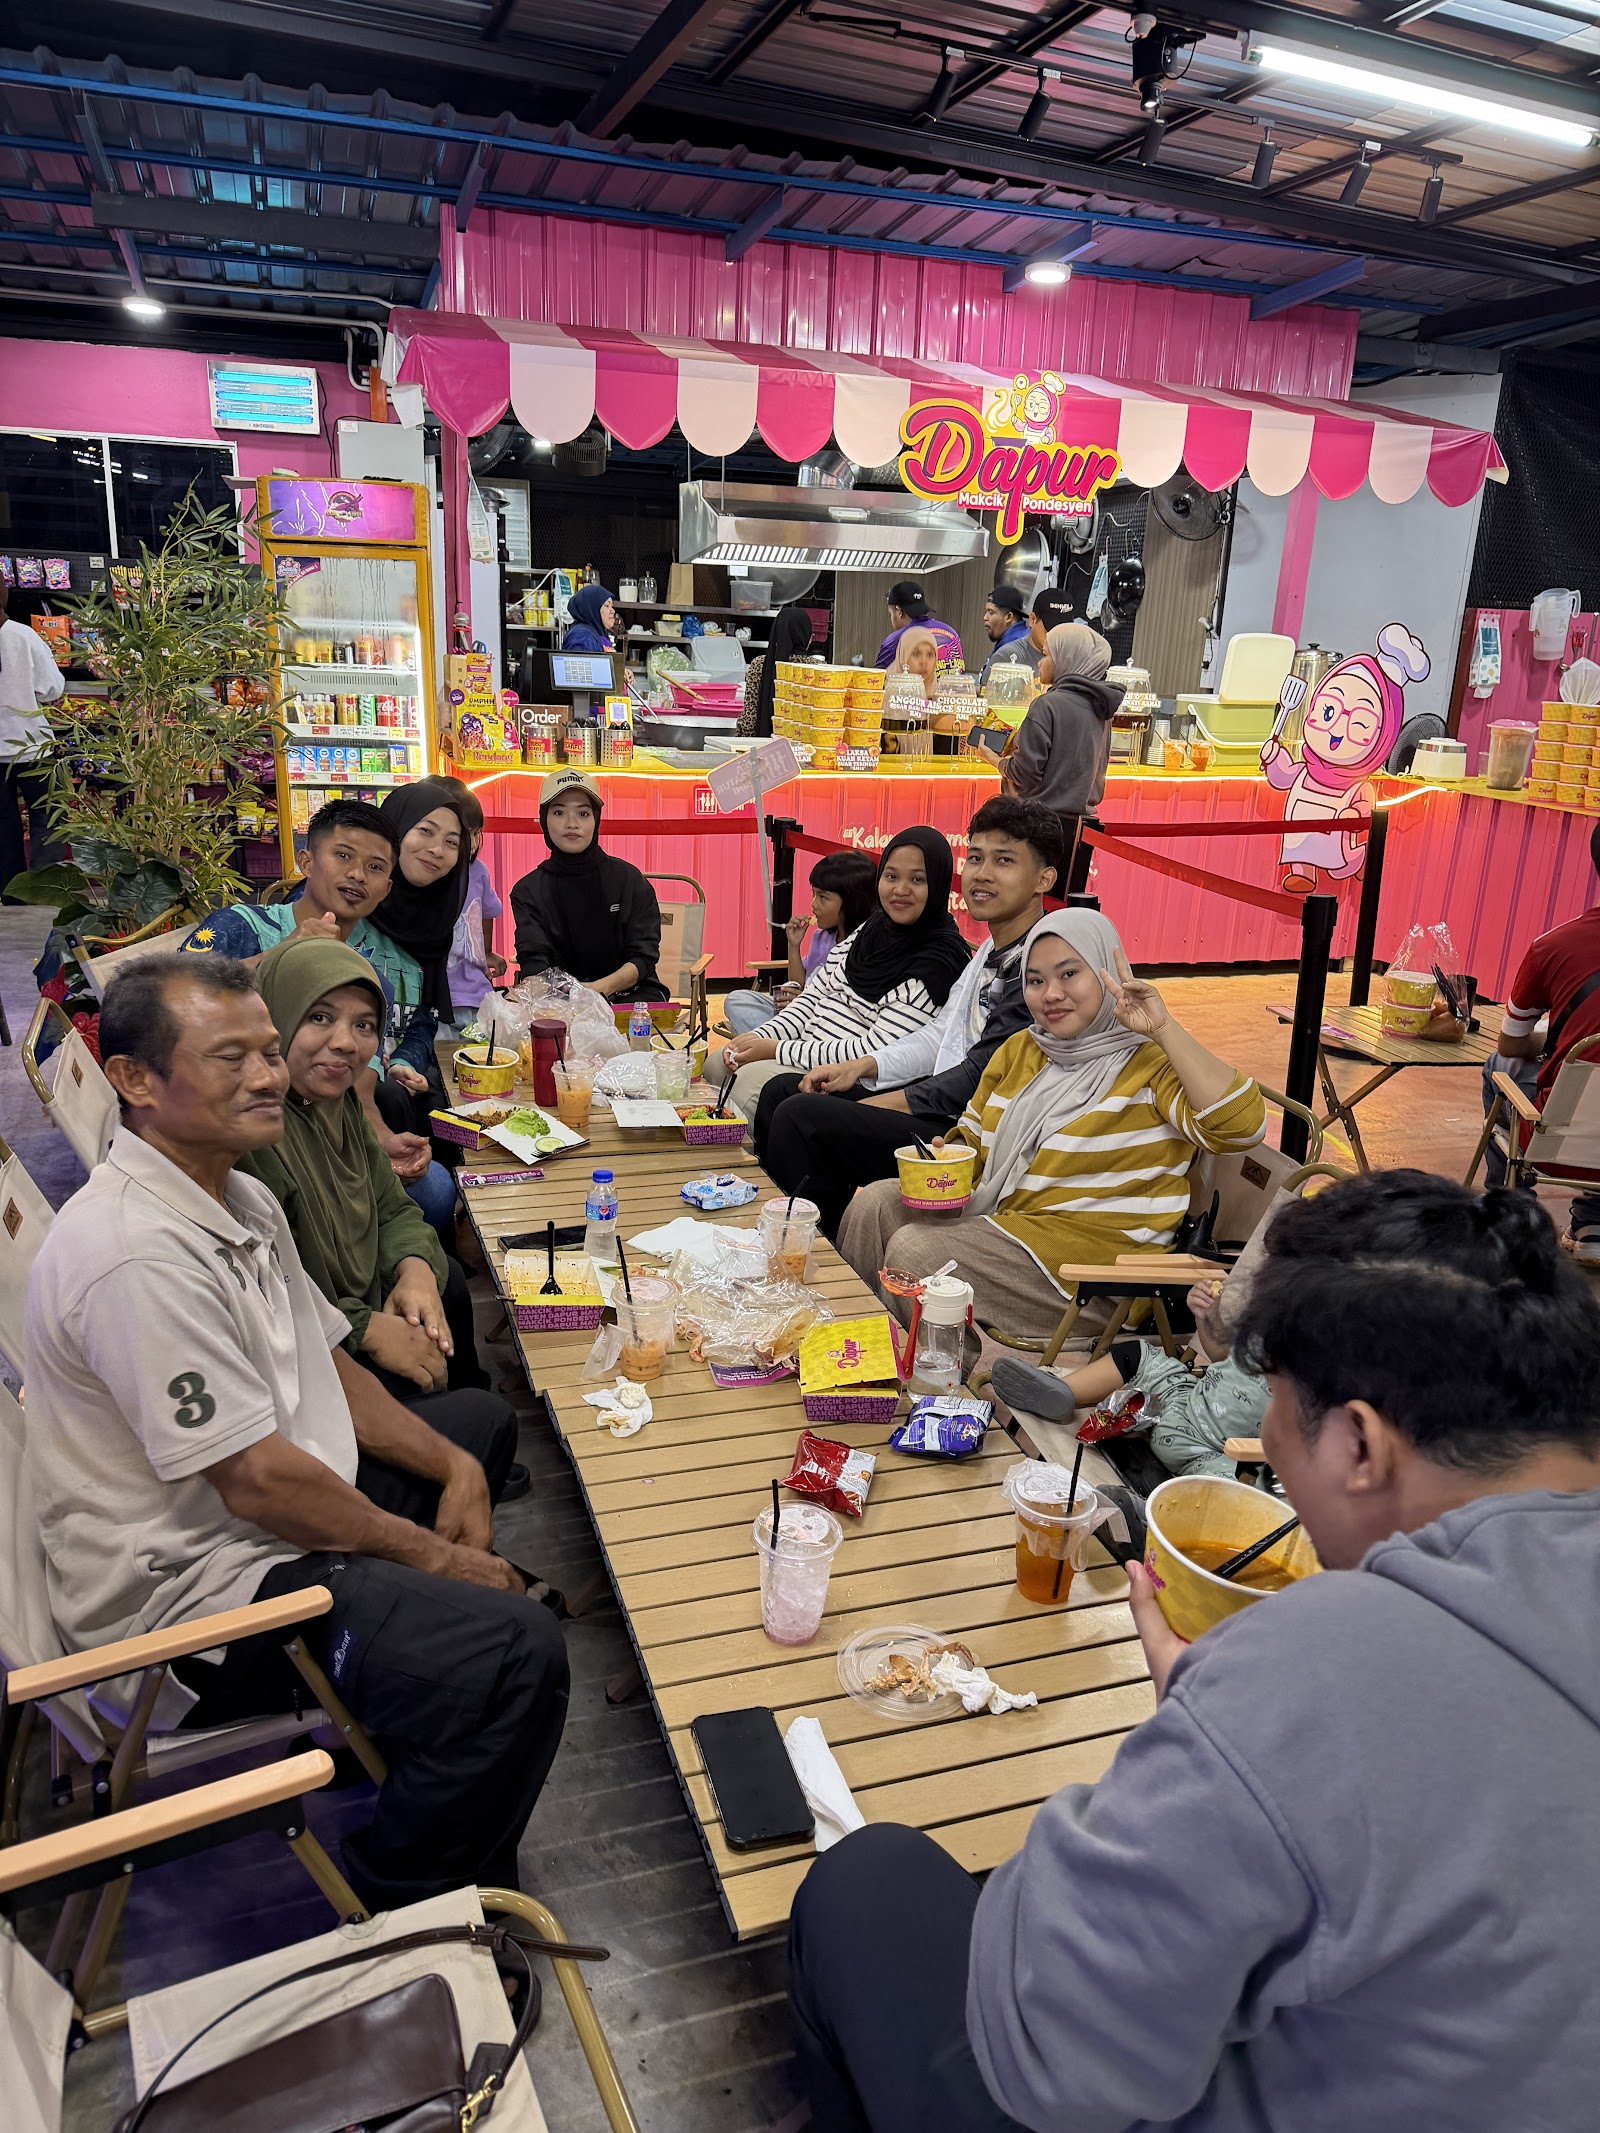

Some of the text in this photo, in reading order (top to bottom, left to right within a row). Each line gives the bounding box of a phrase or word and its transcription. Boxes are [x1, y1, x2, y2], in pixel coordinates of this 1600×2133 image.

[905, 404, 1119, 538] Dapur
[958, 491, 1093, 514] Makcik Pondesyen
[890, 696, 925, 708] ANGGUR
[938, 697, 988, 707] CHOCOLATE
[521, 709, 562, 724] Order
[461, 1075, 481, 1088] Dapur
[926, 1177, 958, 1193] Dapur
[518, 1307, 552, 1315] MAKCIK
[548, 1311, 578, 1319] DAPUR
[518, 1318, 552, 1326] MAKCIK
[168, 1371, 216, 1428] 3
